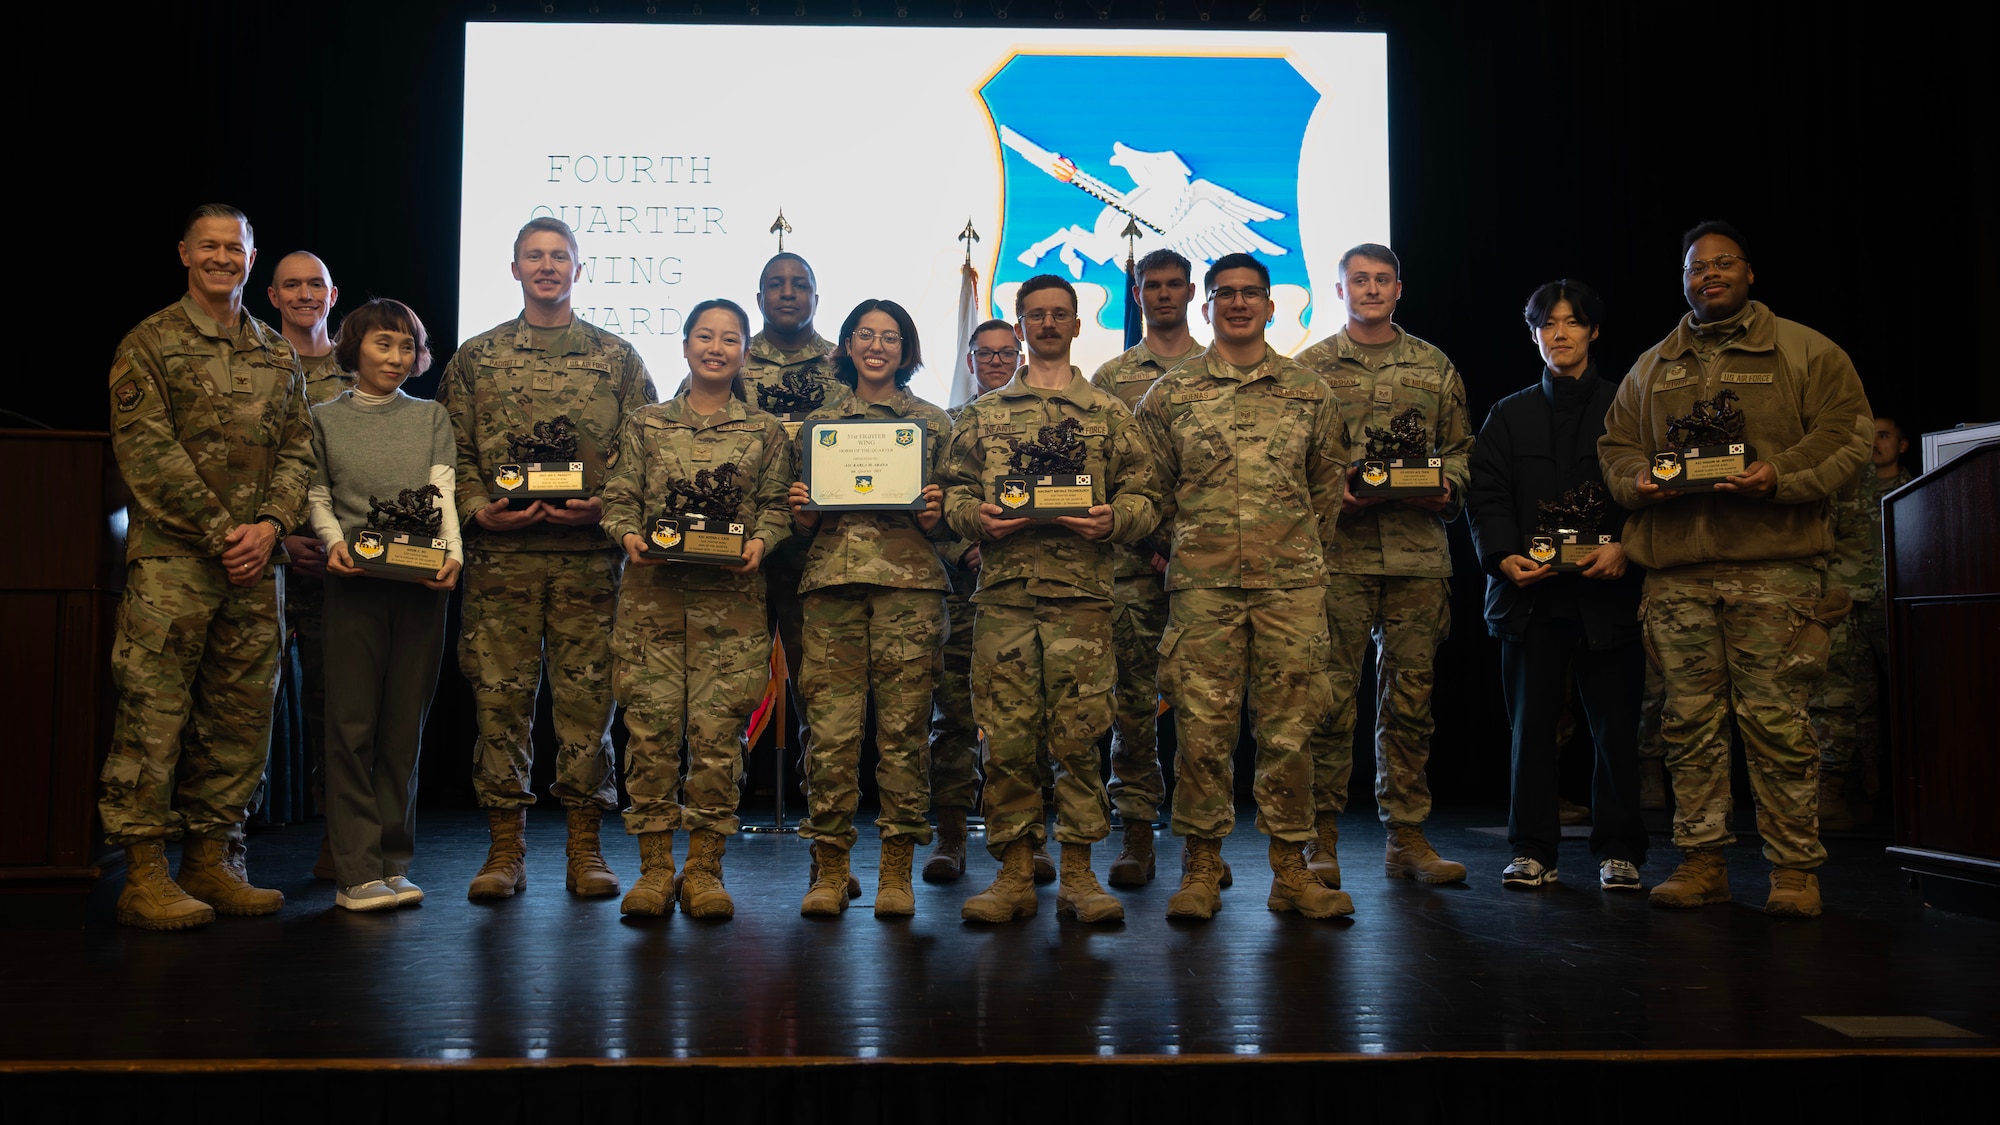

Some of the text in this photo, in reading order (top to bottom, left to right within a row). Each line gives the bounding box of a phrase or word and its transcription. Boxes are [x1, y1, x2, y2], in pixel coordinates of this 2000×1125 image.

[547, 155, 712, 183] FOURTH
[489, 359, 517, 367] PADGETT
[592, 361, 609, 370] FORCE
[1736, 374, 1747, 382] AIR
[1748, 374, 1771, 382] FORCE
[984, 424, 1017, 434] INFANTE
[1085, 426, 1106, 434] FORCE
